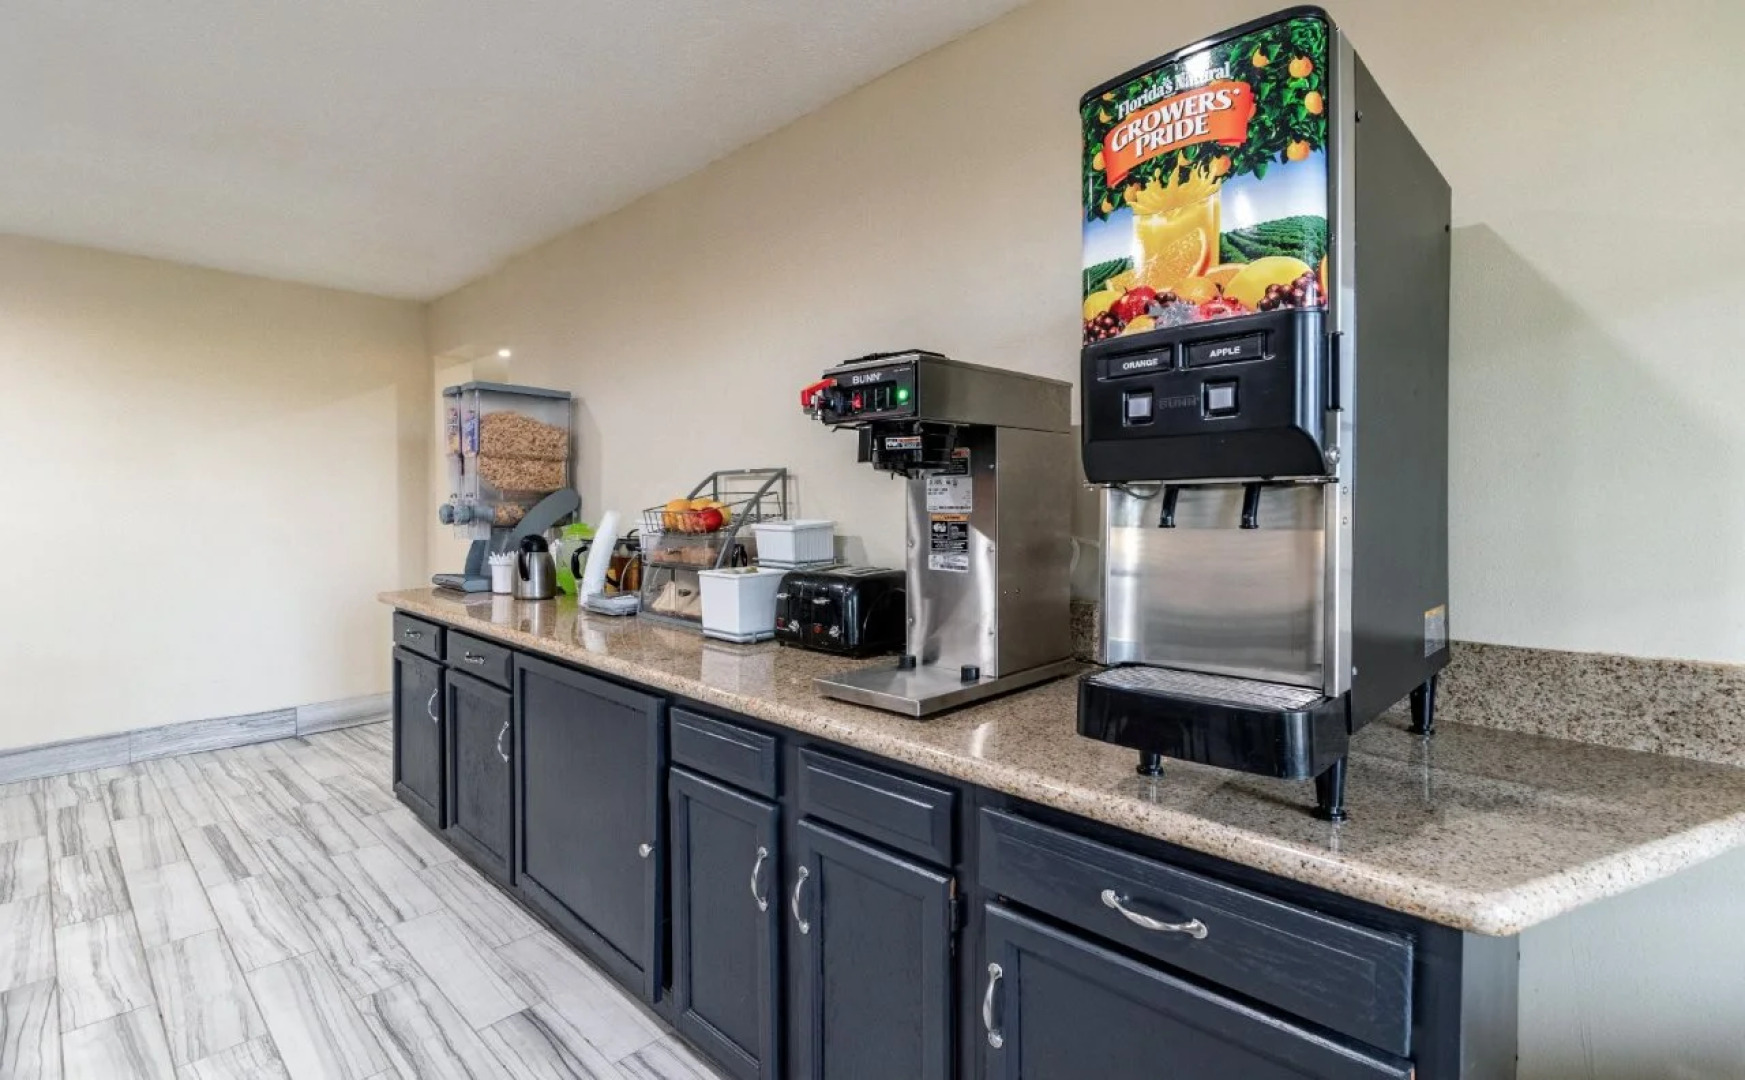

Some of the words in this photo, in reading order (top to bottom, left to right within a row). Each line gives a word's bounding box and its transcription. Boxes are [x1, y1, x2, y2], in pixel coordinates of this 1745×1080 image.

[1111, 88, 1233, 153] GROWERS
[1135, 114, 1210, 158] PRIDE
[1209, 345, 1241, 358] APPLE
[1122, 358, 1159, 371] ORANGE
[852, 372, 882, 385] BUNN
